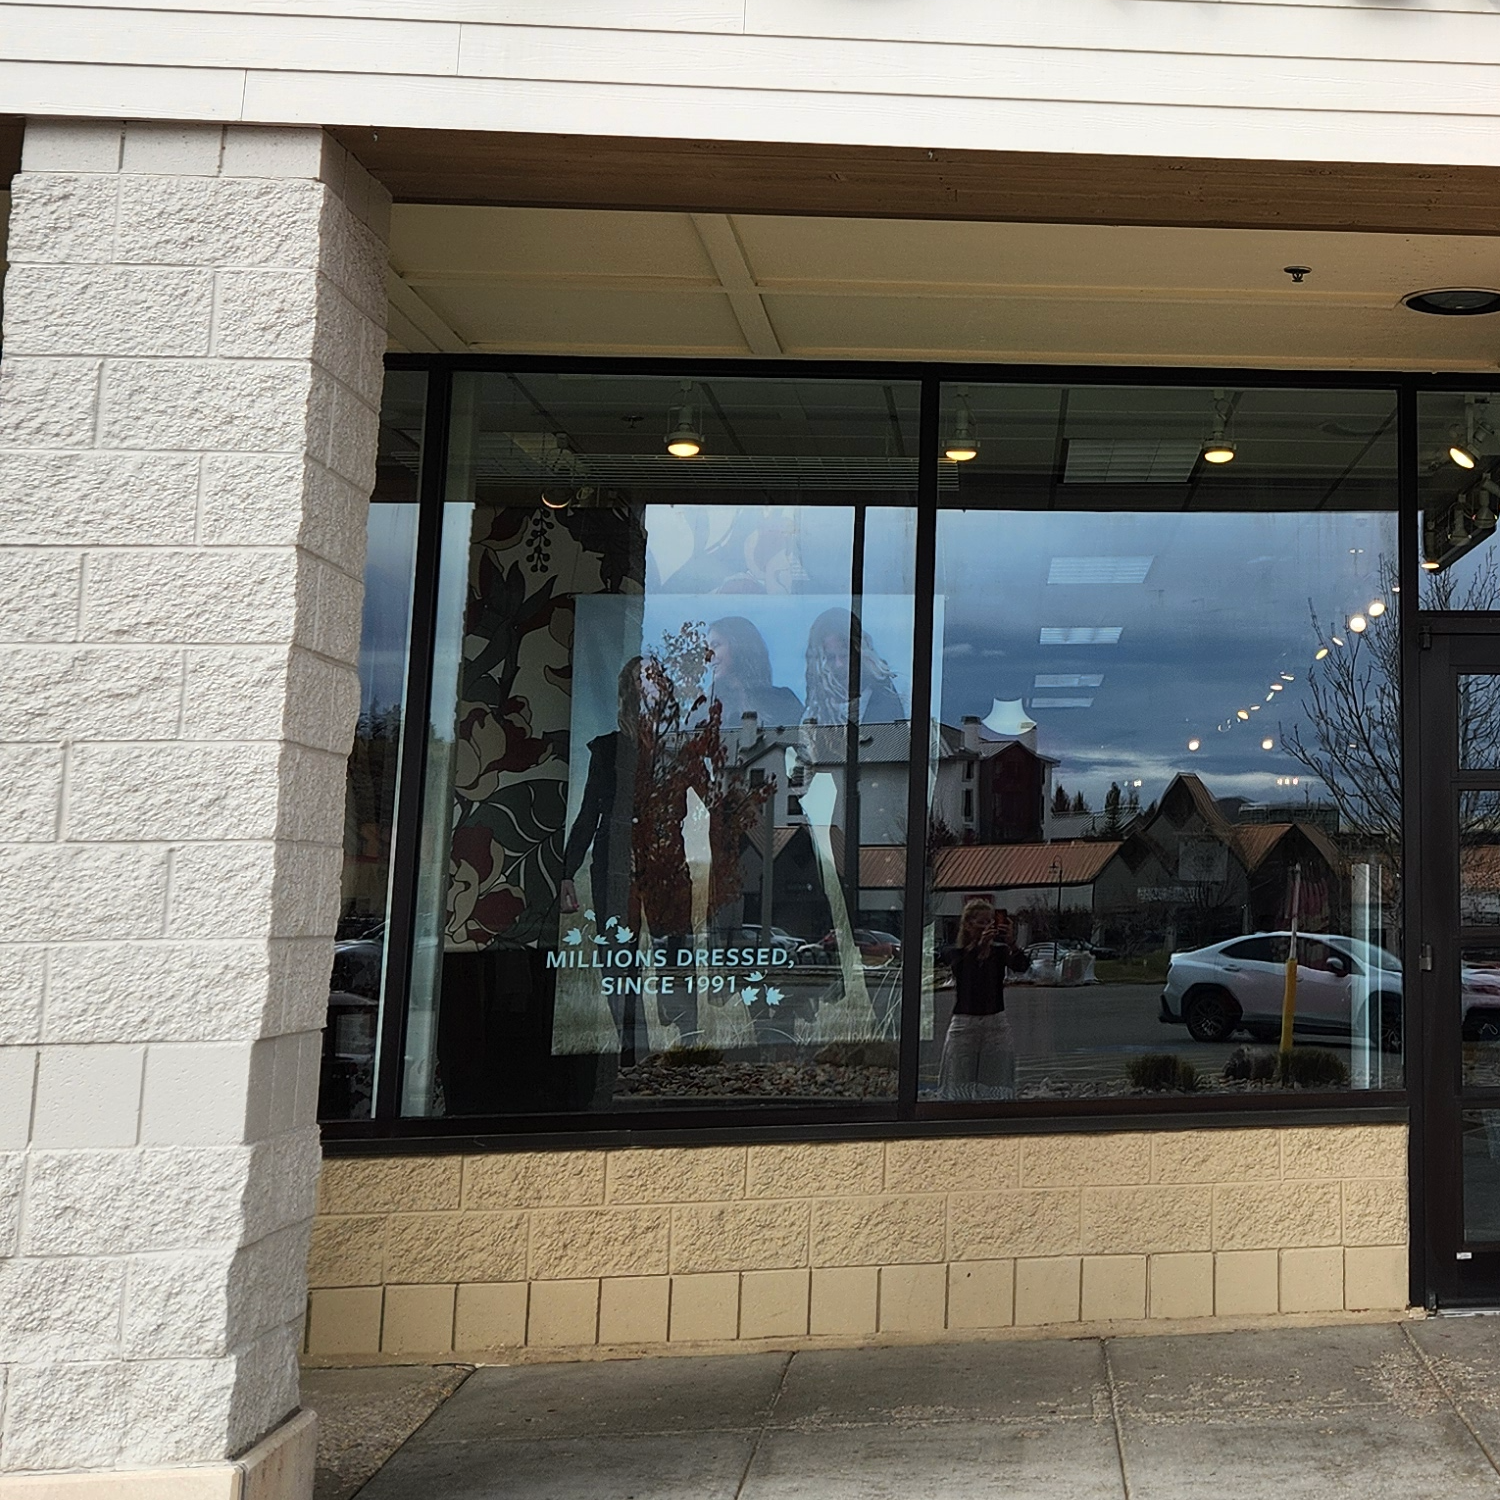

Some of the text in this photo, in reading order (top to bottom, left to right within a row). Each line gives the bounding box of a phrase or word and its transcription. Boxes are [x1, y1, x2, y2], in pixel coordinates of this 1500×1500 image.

[545, 947, 795, 969] MILLIONS DRESSED,
[601, 975, 736, 996] SINCE 1991
